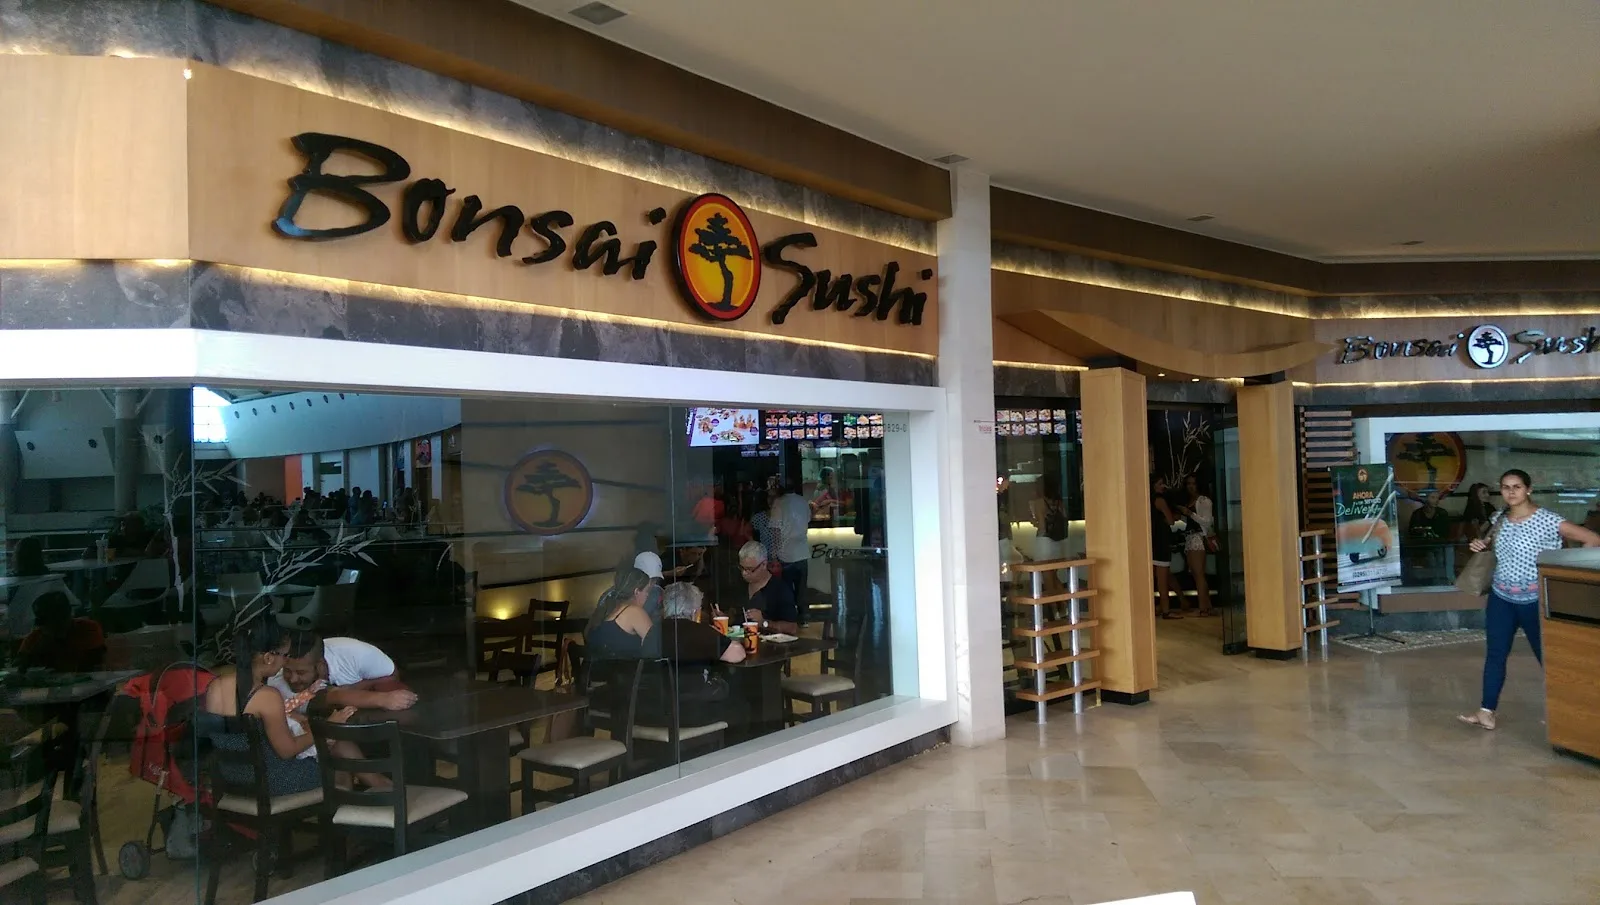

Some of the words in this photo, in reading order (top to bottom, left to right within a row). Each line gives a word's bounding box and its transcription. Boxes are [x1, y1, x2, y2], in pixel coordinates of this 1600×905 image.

[271, 131, 666, 281] Bonsai
[764, 231, 934, 326] Sushi
[1341, 331, 1465, 364] Bonsai
[1352, 491, 1374, 500] AHORA
